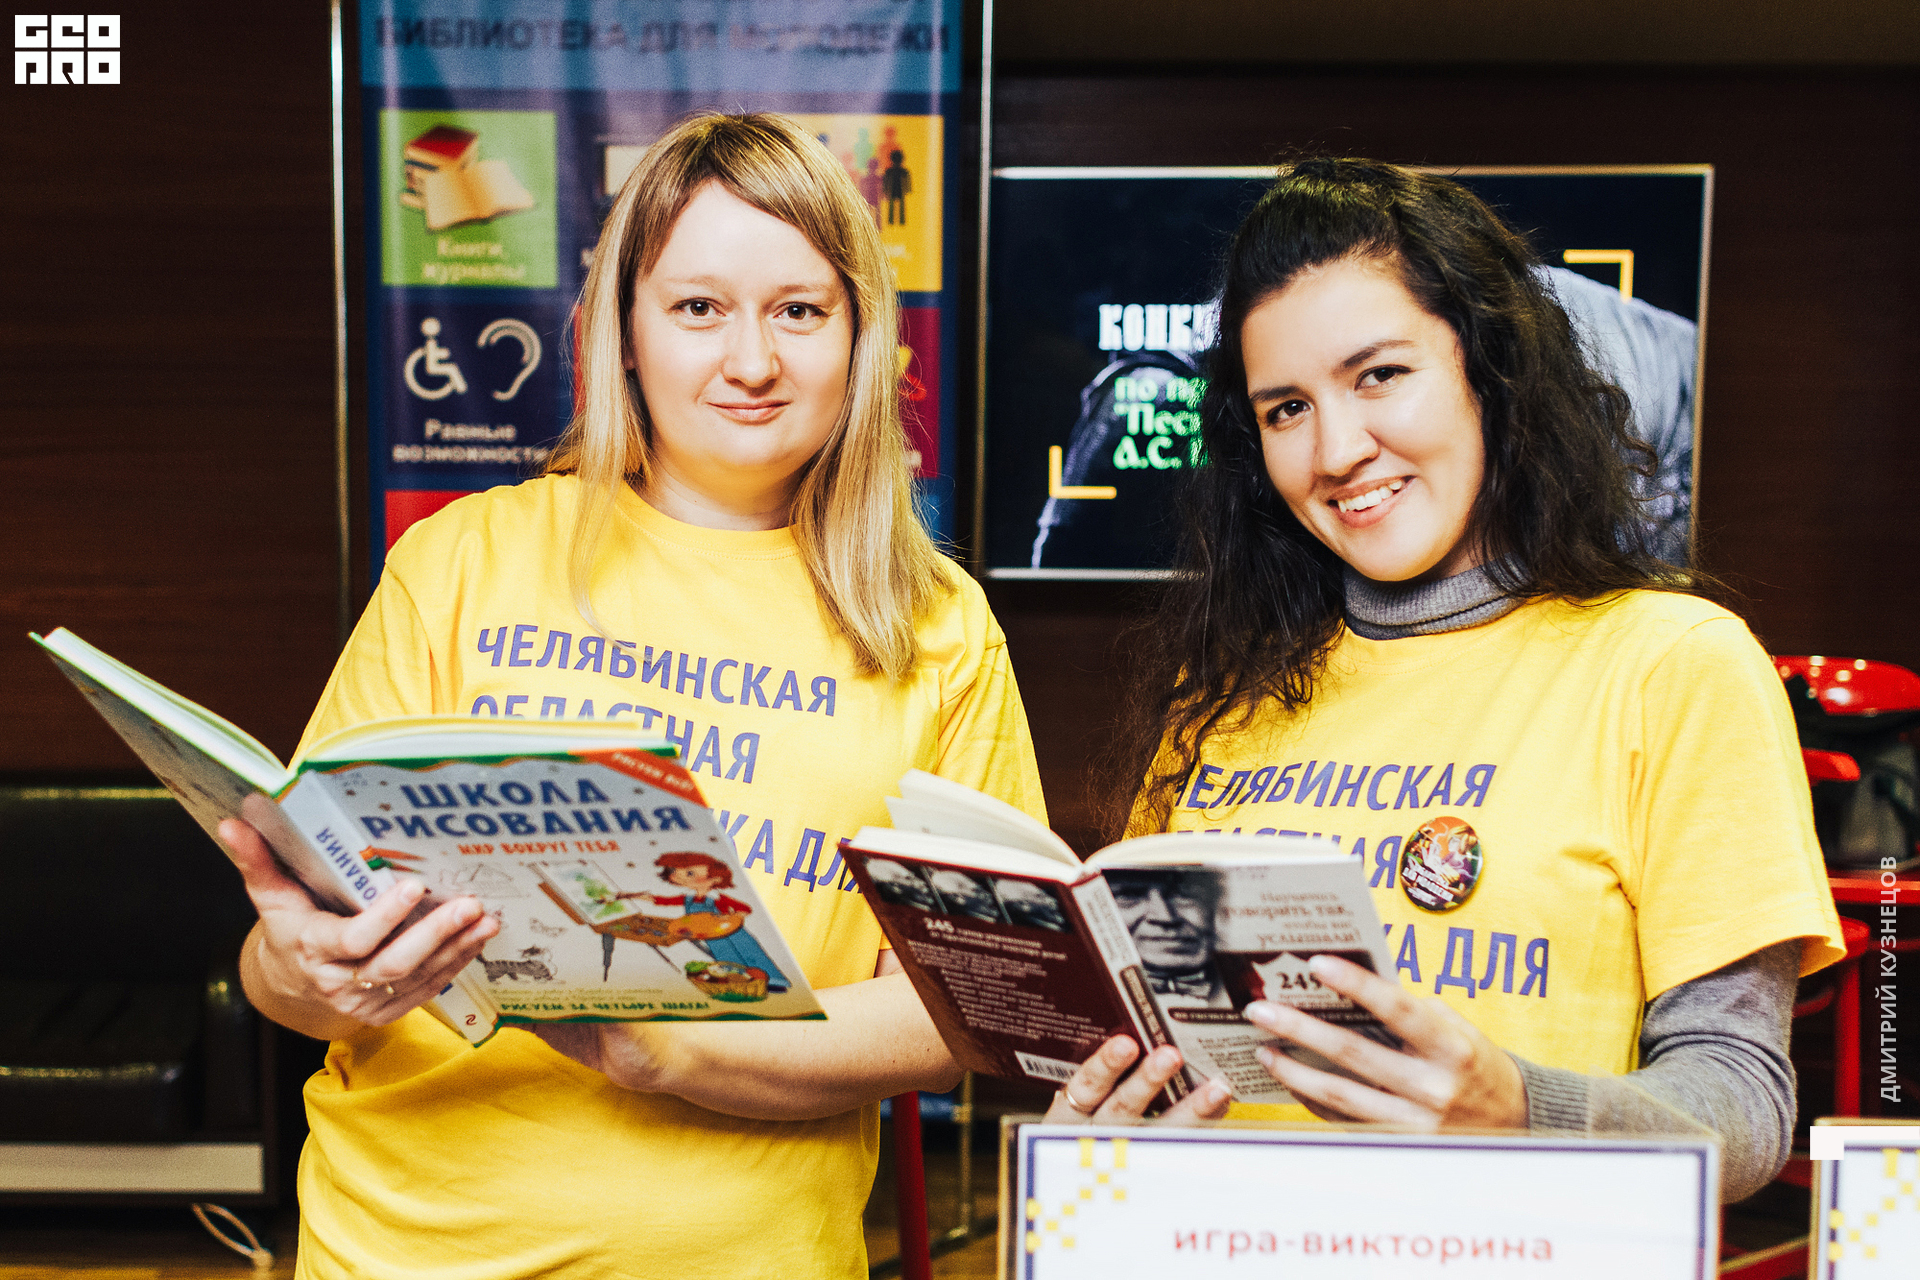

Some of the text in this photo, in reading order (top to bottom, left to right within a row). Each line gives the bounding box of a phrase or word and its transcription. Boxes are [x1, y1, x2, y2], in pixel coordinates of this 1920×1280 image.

[376, 18, 629, 51] БИБЛИОТЕКА
[641, 21, 718, 54] ДЛЯ
[1098, 303, 1220, 352] КОНК
[1114, 377, 1159, 402] по
[424, 418, 517, 442] Равные
[392, 444, 549, 464] возможности
[477, 624, 837, 717] ЧЕЛЯБИНСКАЯ
[399, 778, 611, 810] ШКОЛА
[359, 806, 693, 839] РИСОВАНИЯ
[316, 826, 378, 900] ОВАНИЯ
[573, 839, 621, 853] ТЕБЯ
[784, 828, 862, 893] ДЛ
[1435, 927, 1549, 998] ДЛЯ
[1276, 971, 1323, 990] 245
[1173, 1227, 1554, 1264] игра-викторина
